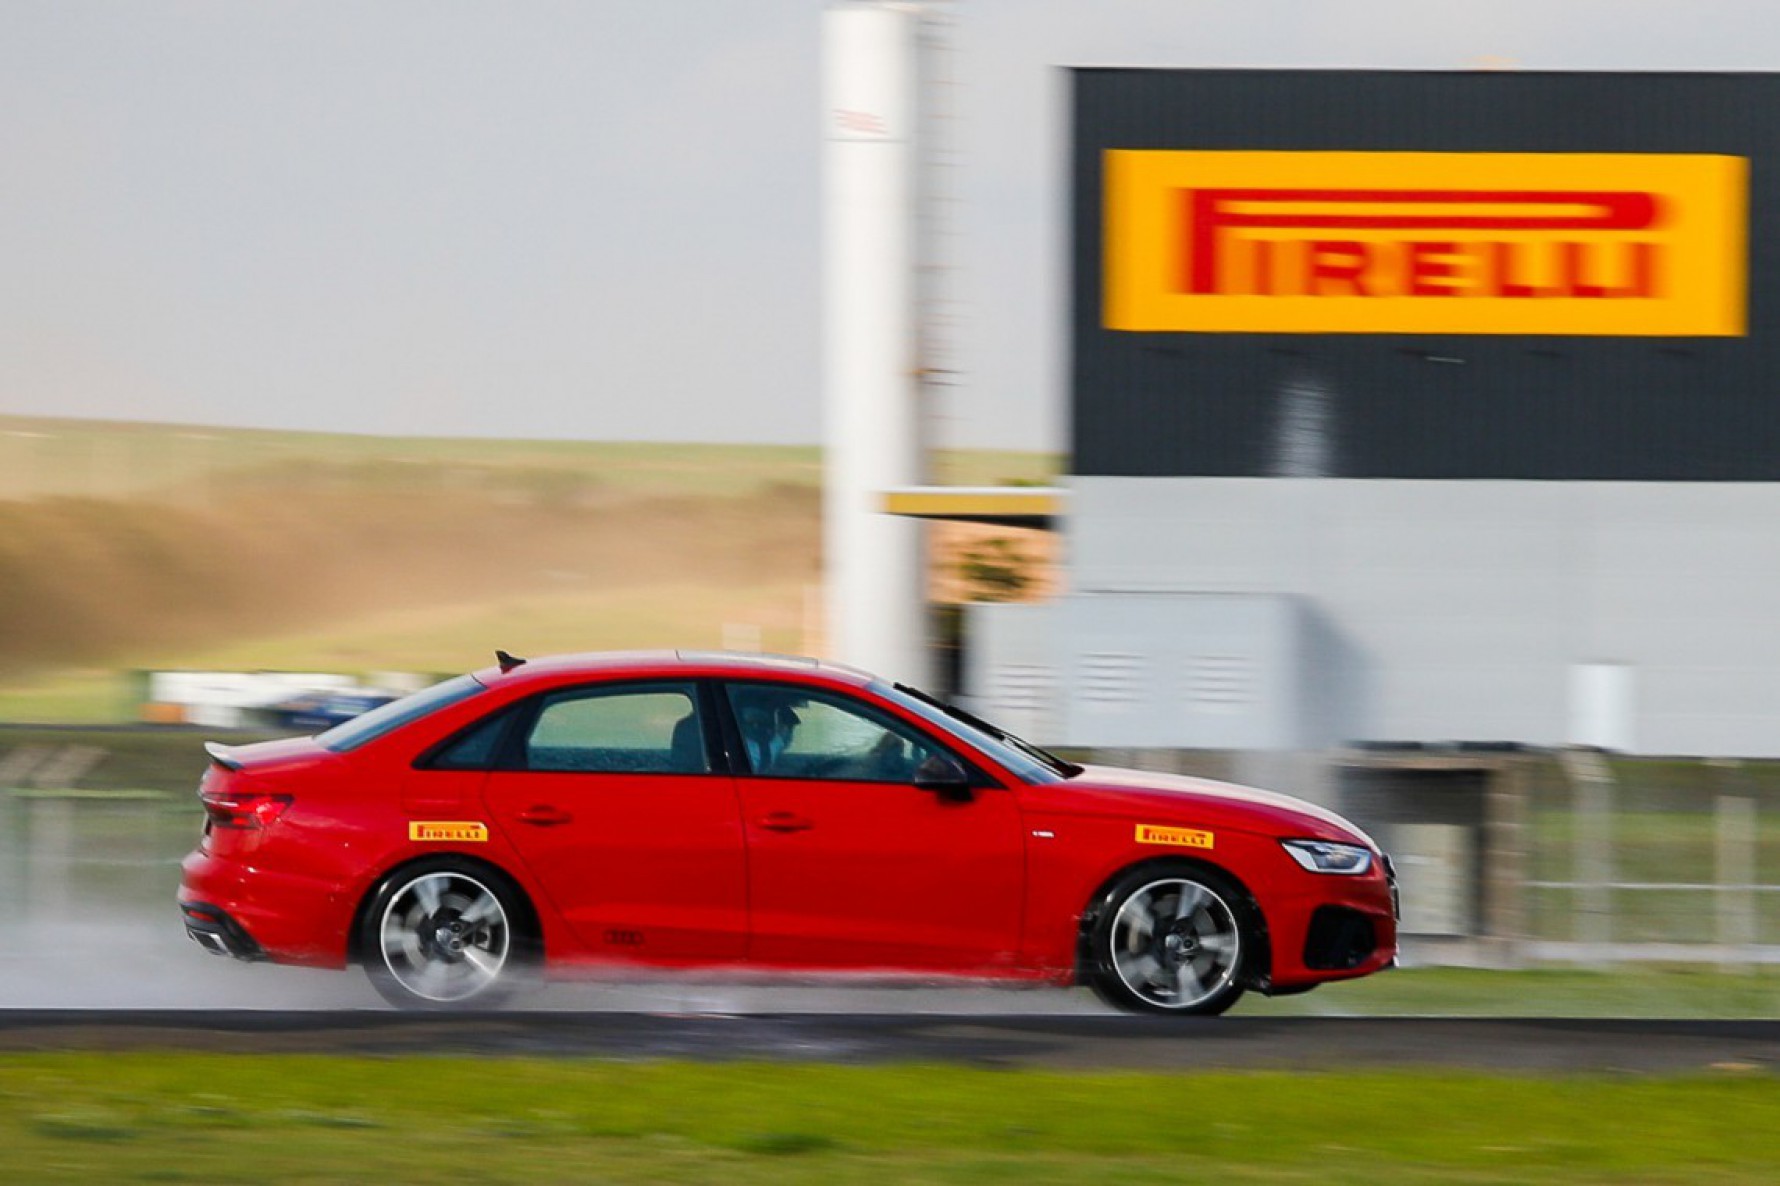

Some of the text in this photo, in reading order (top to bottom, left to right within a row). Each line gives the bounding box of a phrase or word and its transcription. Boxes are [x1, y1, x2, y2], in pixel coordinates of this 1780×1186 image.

[1176, 188, 1667, 298] PIRELLI
[417, 824, 481, 838] PIRELLI
[1143, 827, 1206, 845] PIRELLI
